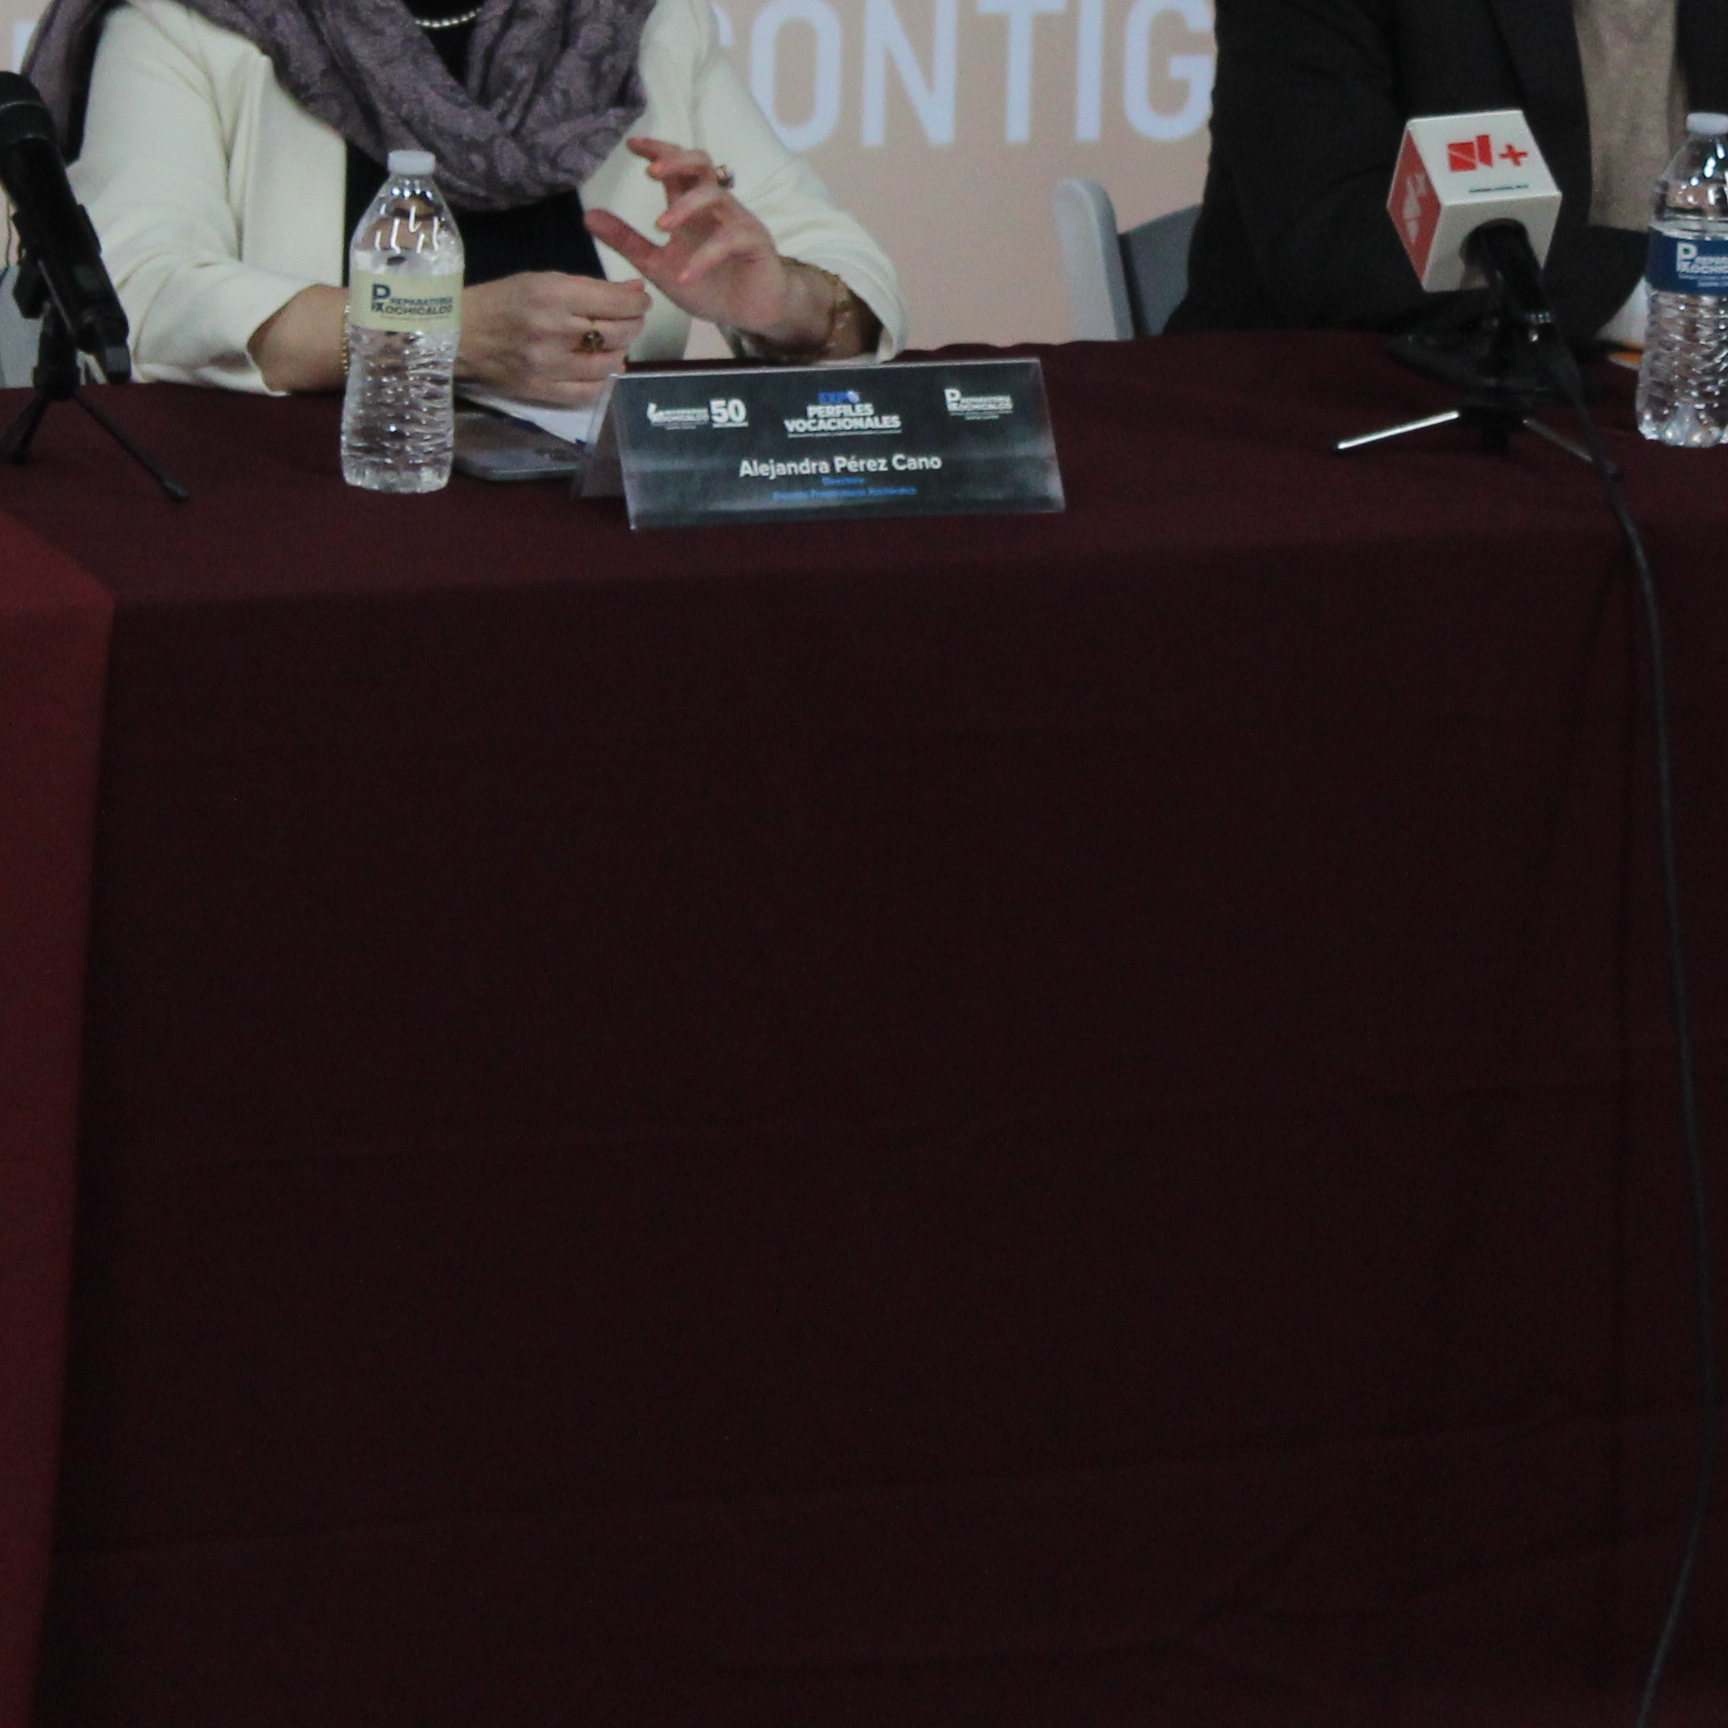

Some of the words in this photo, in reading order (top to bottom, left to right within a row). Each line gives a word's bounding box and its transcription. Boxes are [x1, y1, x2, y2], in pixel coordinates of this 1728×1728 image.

[710, 398, 747, 423] 50
[806, 403, 874, 419] PERFILES
[783, 414, 902, 433] VOCACIONALES
[739, 457, 830, 480] Alejandra
[833, 454, 888, 473] Pérez
[891, 453, 942, 471] Cano
